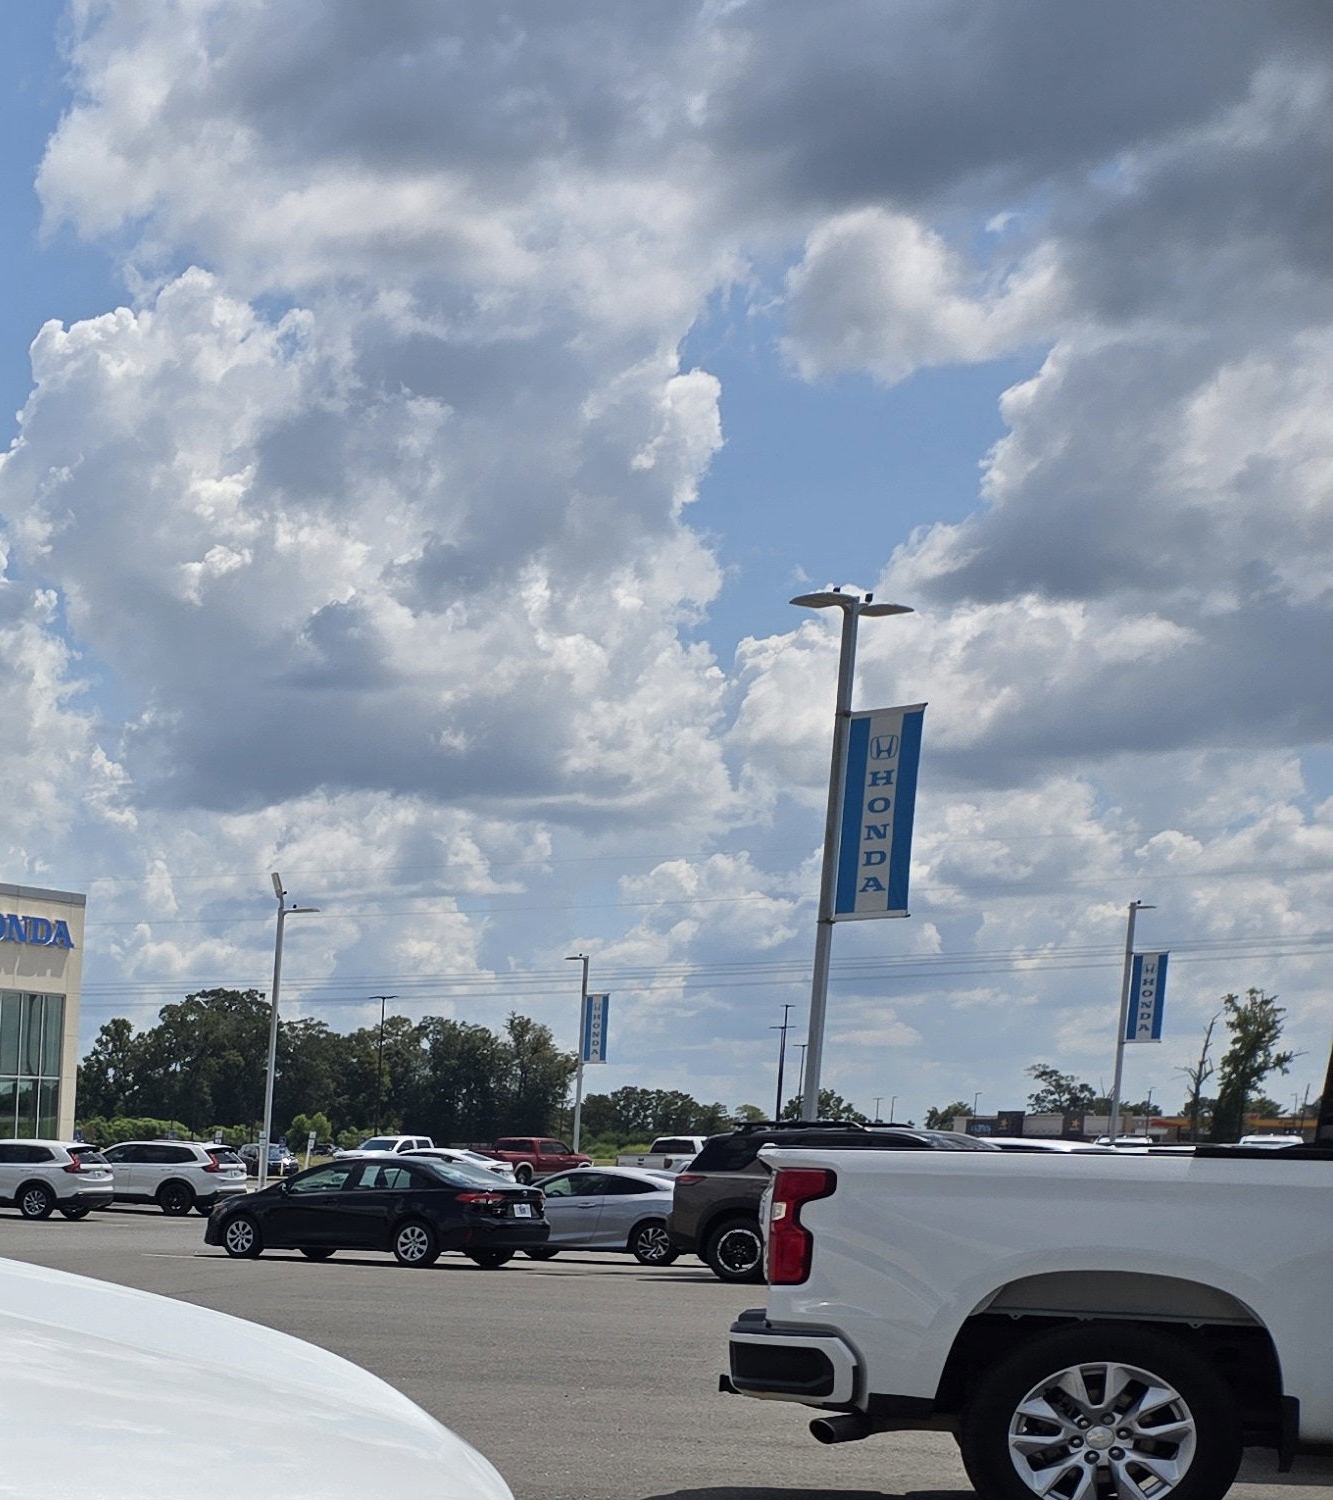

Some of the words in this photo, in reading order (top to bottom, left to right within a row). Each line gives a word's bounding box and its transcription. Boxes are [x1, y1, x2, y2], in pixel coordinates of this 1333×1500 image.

[858, 768, 895, 893] HONDA
[1138, 976, 1155, 1033] HONDA
[591, 1014, 601, 1055] HONDA
